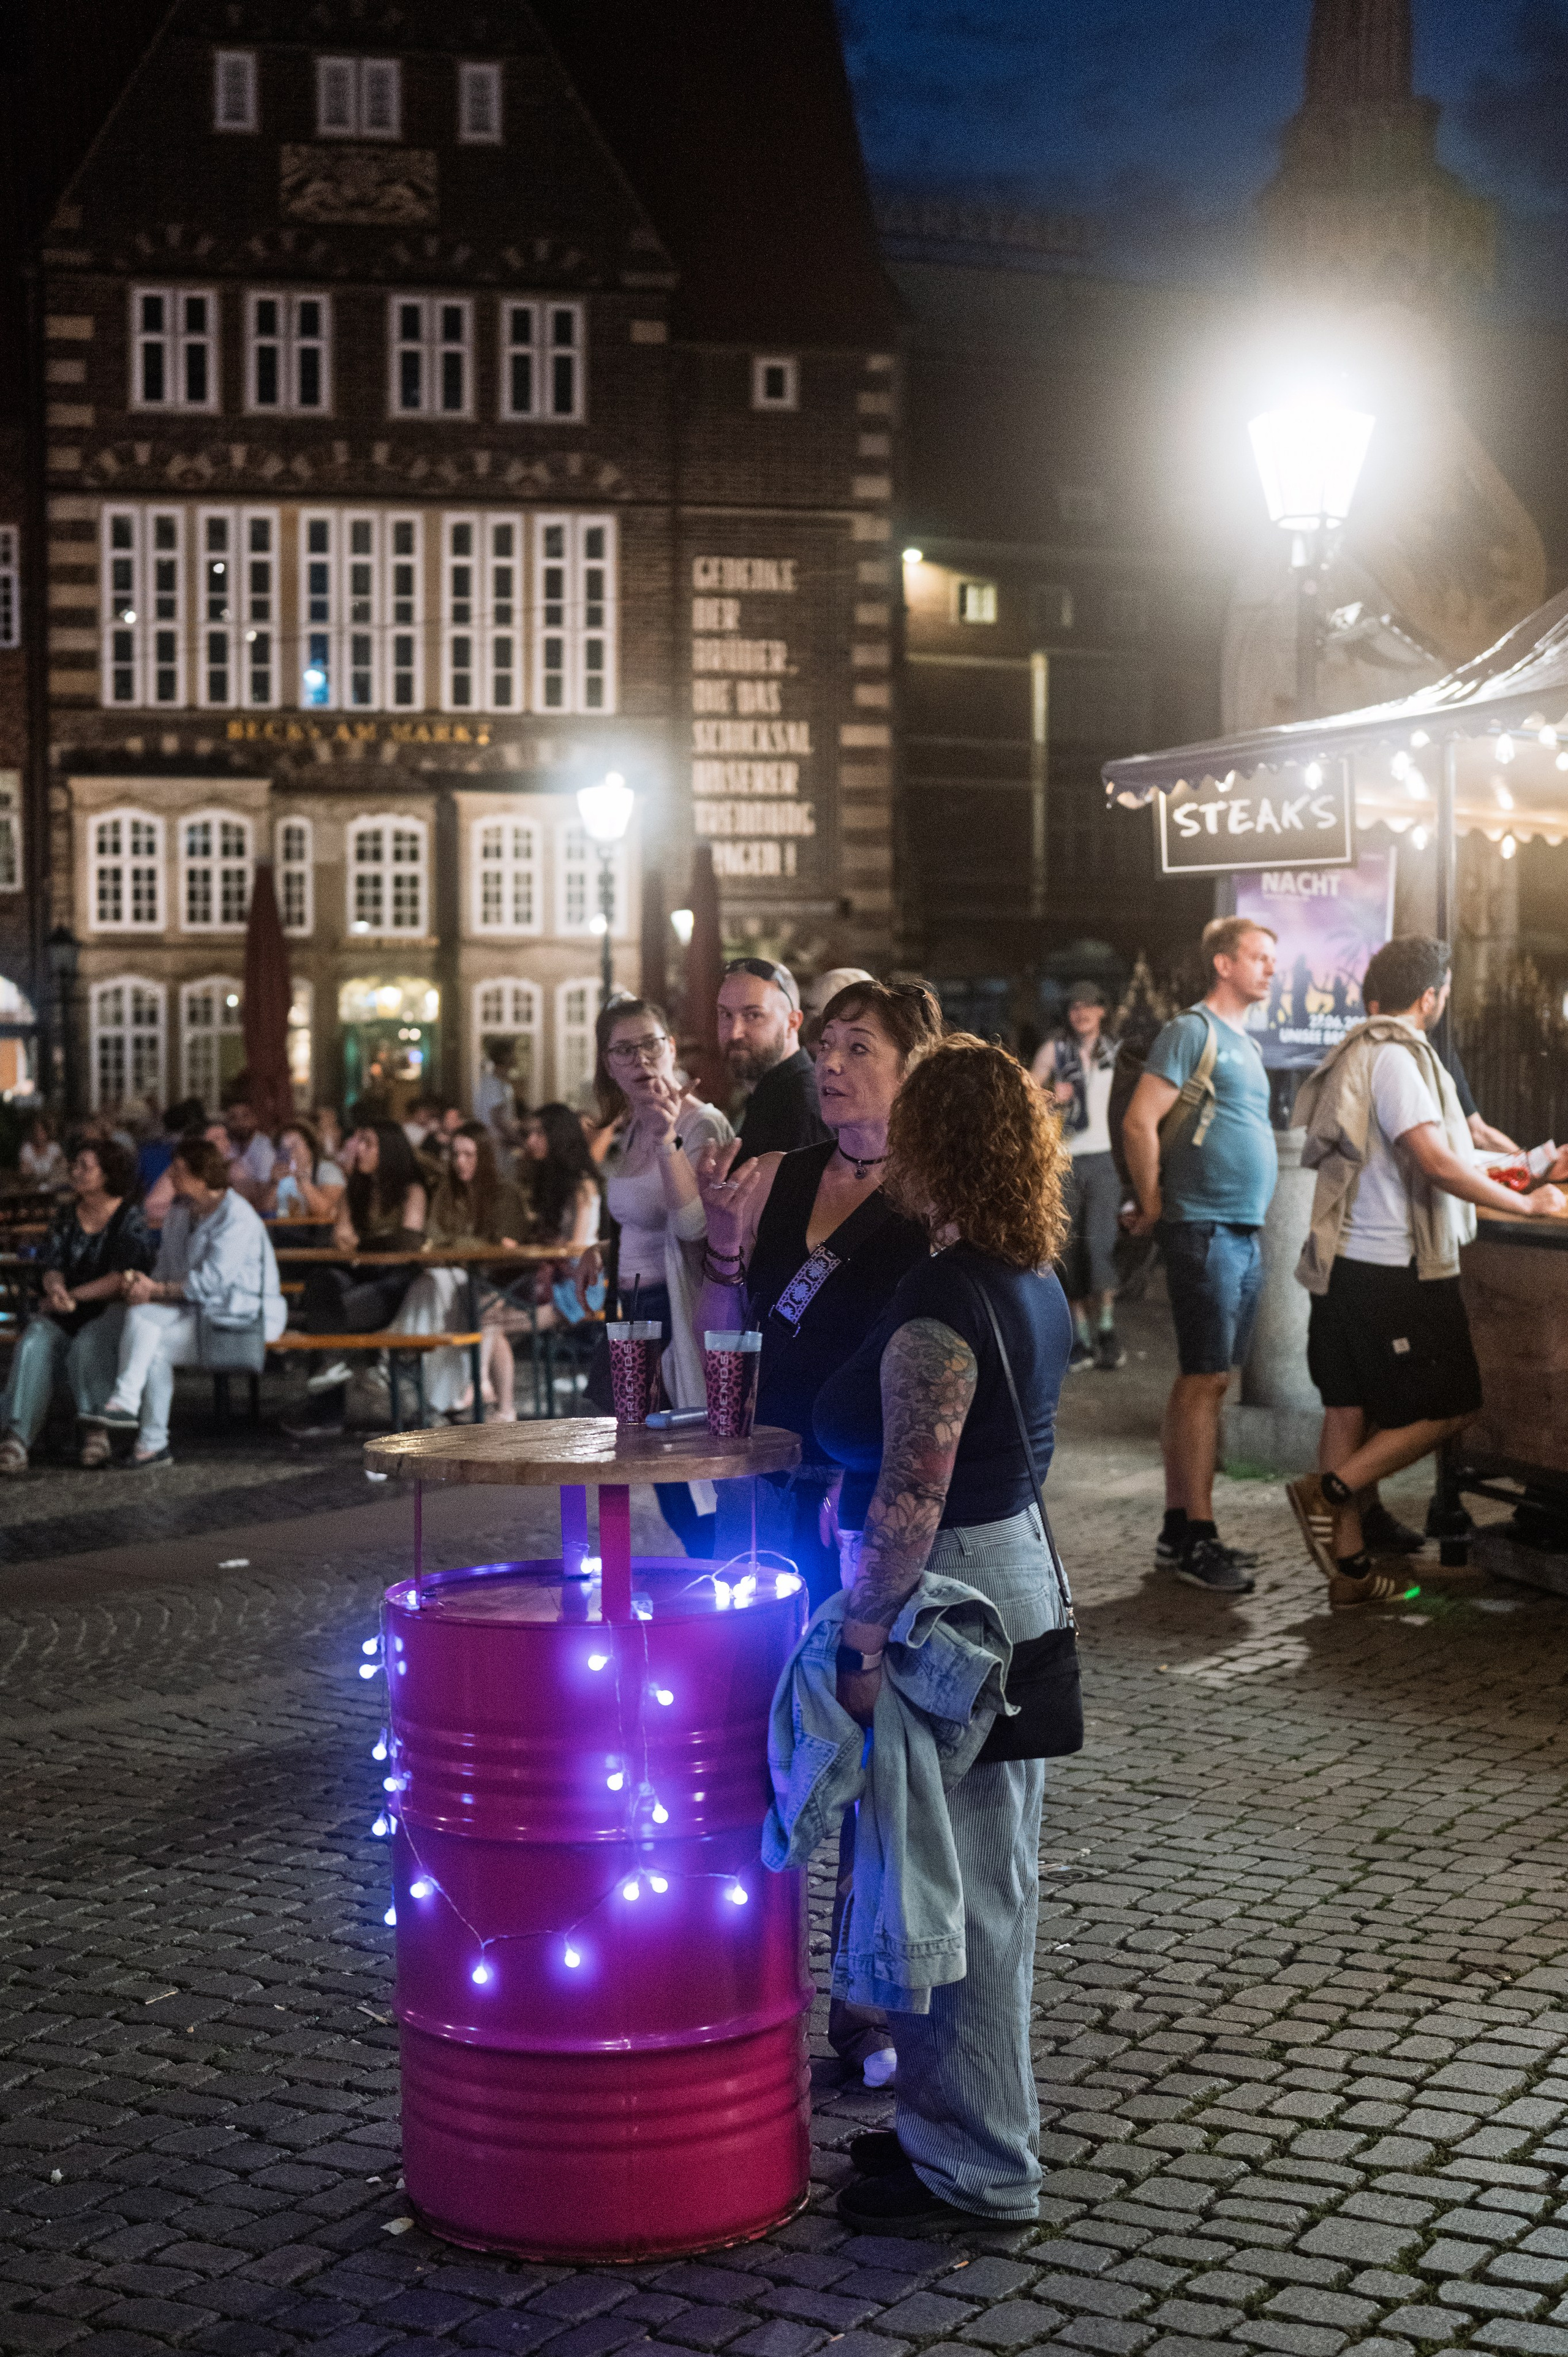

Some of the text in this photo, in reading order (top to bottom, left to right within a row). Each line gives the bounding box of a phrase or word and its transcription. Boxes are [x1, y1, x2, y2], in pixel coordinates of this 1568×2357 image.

[1172, 794, 1337, 838] STEAKS
[1261, 871, 1344, 898] NACHT
[624, 1343, 635, 1422] FRIENDS
[719, 1353, 729, 1436] FRIENDS
